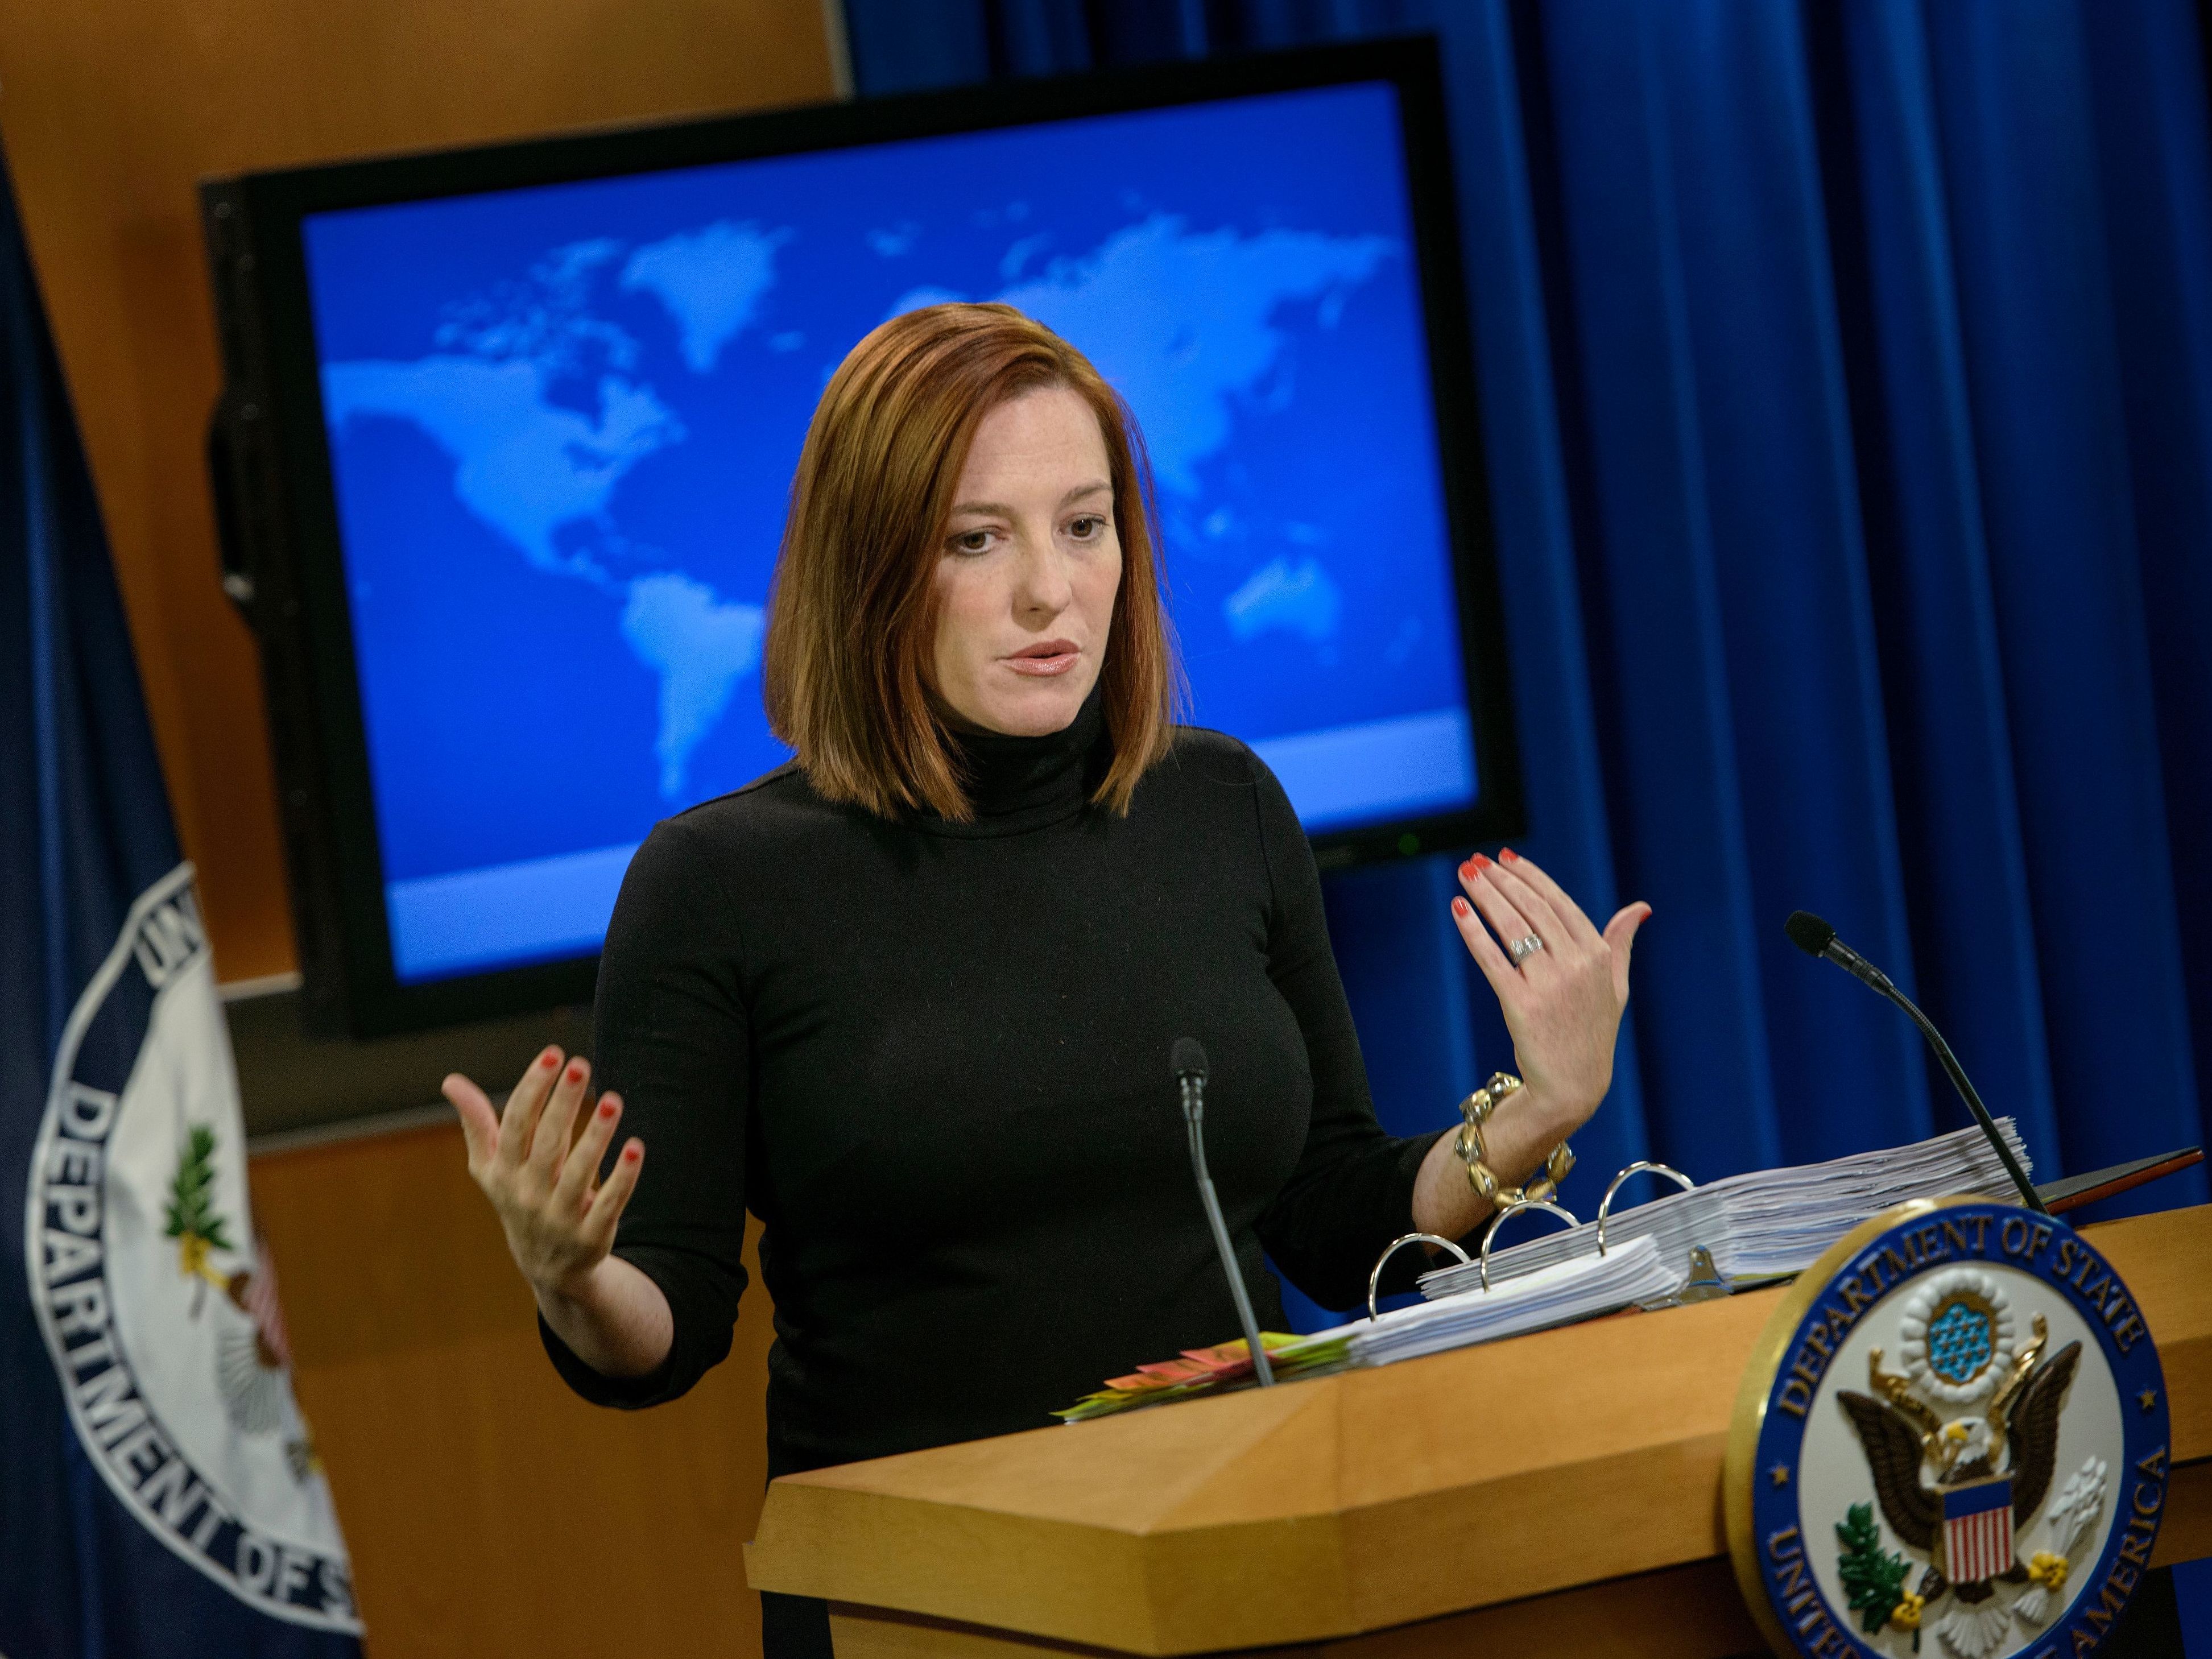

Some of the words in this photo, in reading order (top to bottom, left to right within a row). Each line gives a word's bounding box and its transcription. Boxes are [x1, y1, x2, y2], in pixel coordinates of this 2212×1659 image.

[43, 1082, 226, 1553] DEPARTMENT
[235, 1538, 309, 1604] OF
[1779, 1215, 1992, 1417] DEPARTMENT
[2002, 1216, 2052, 1260] OF
[2052, 1239, 2144, 1354] STATE
[2072, 1447, 2166, 1659] AMERICA
